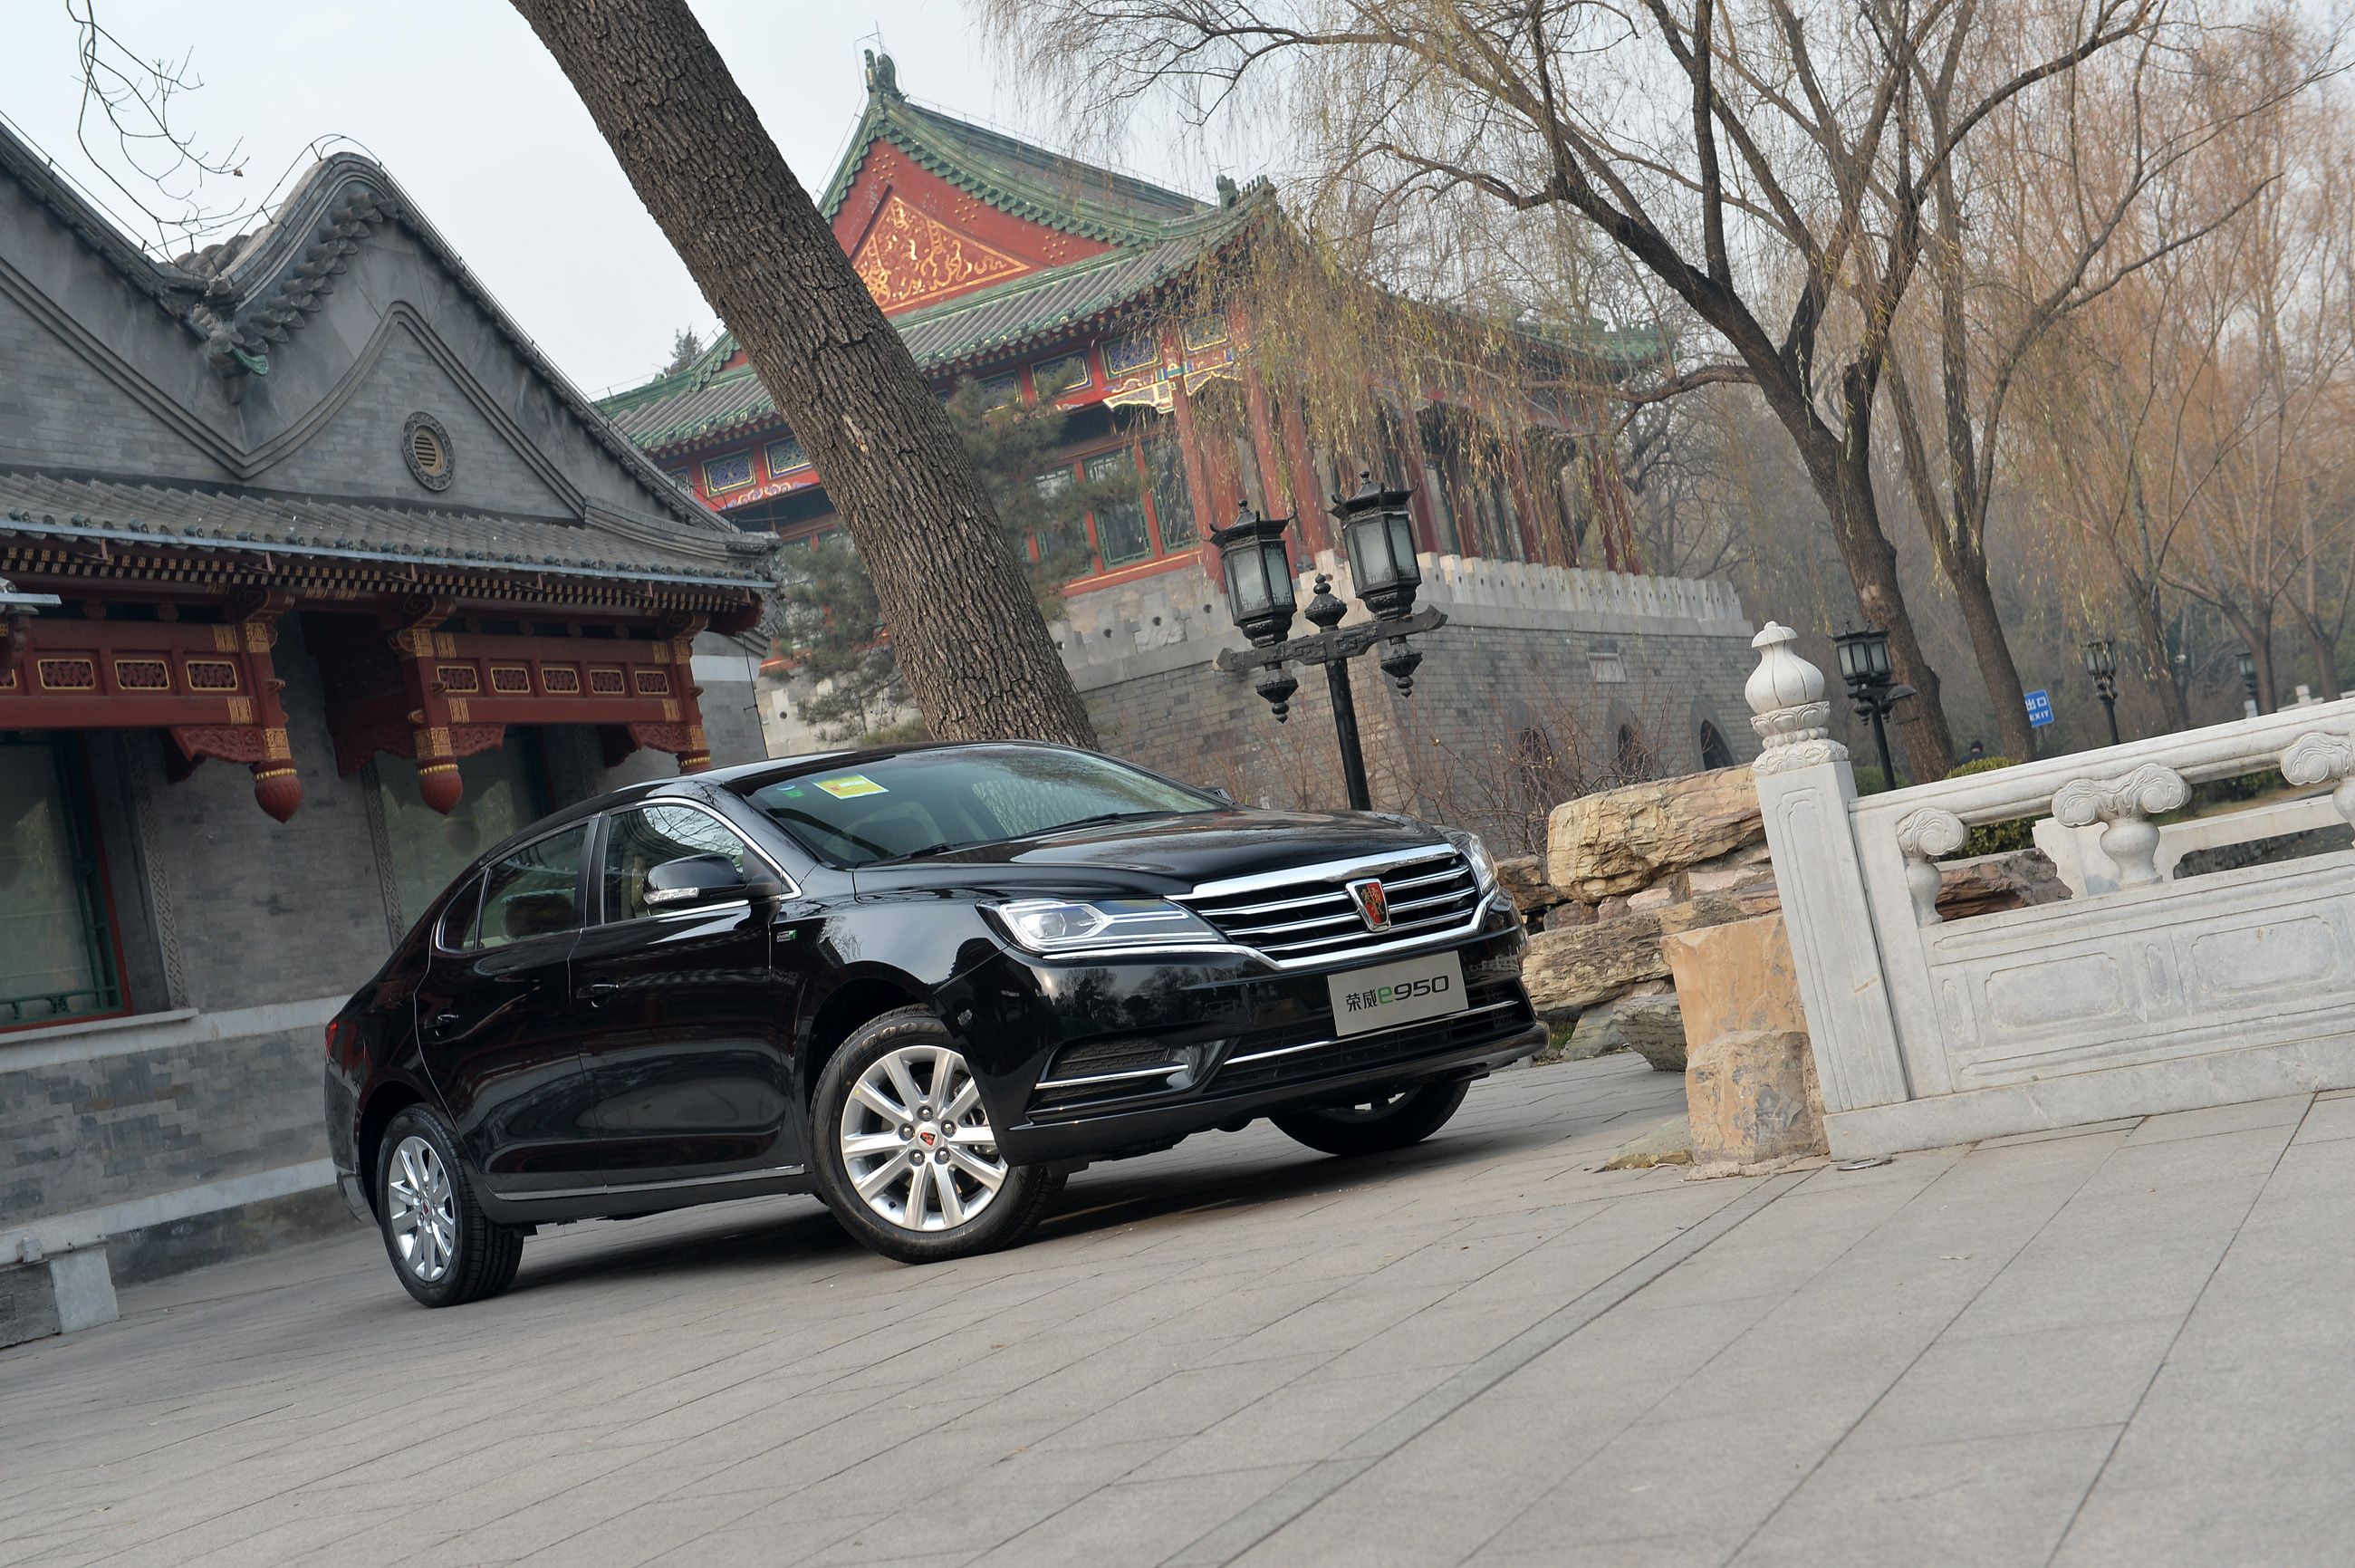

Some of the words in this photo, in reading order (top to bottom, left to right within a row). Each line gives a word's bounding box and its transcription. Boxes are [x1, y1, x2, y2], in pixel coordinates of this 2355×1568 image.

[2024, 697, 2047, 711] 出口
[2029, 710, 2049, 722] EXIT
[1345, 975, 1449, 1013] 荣威e950
